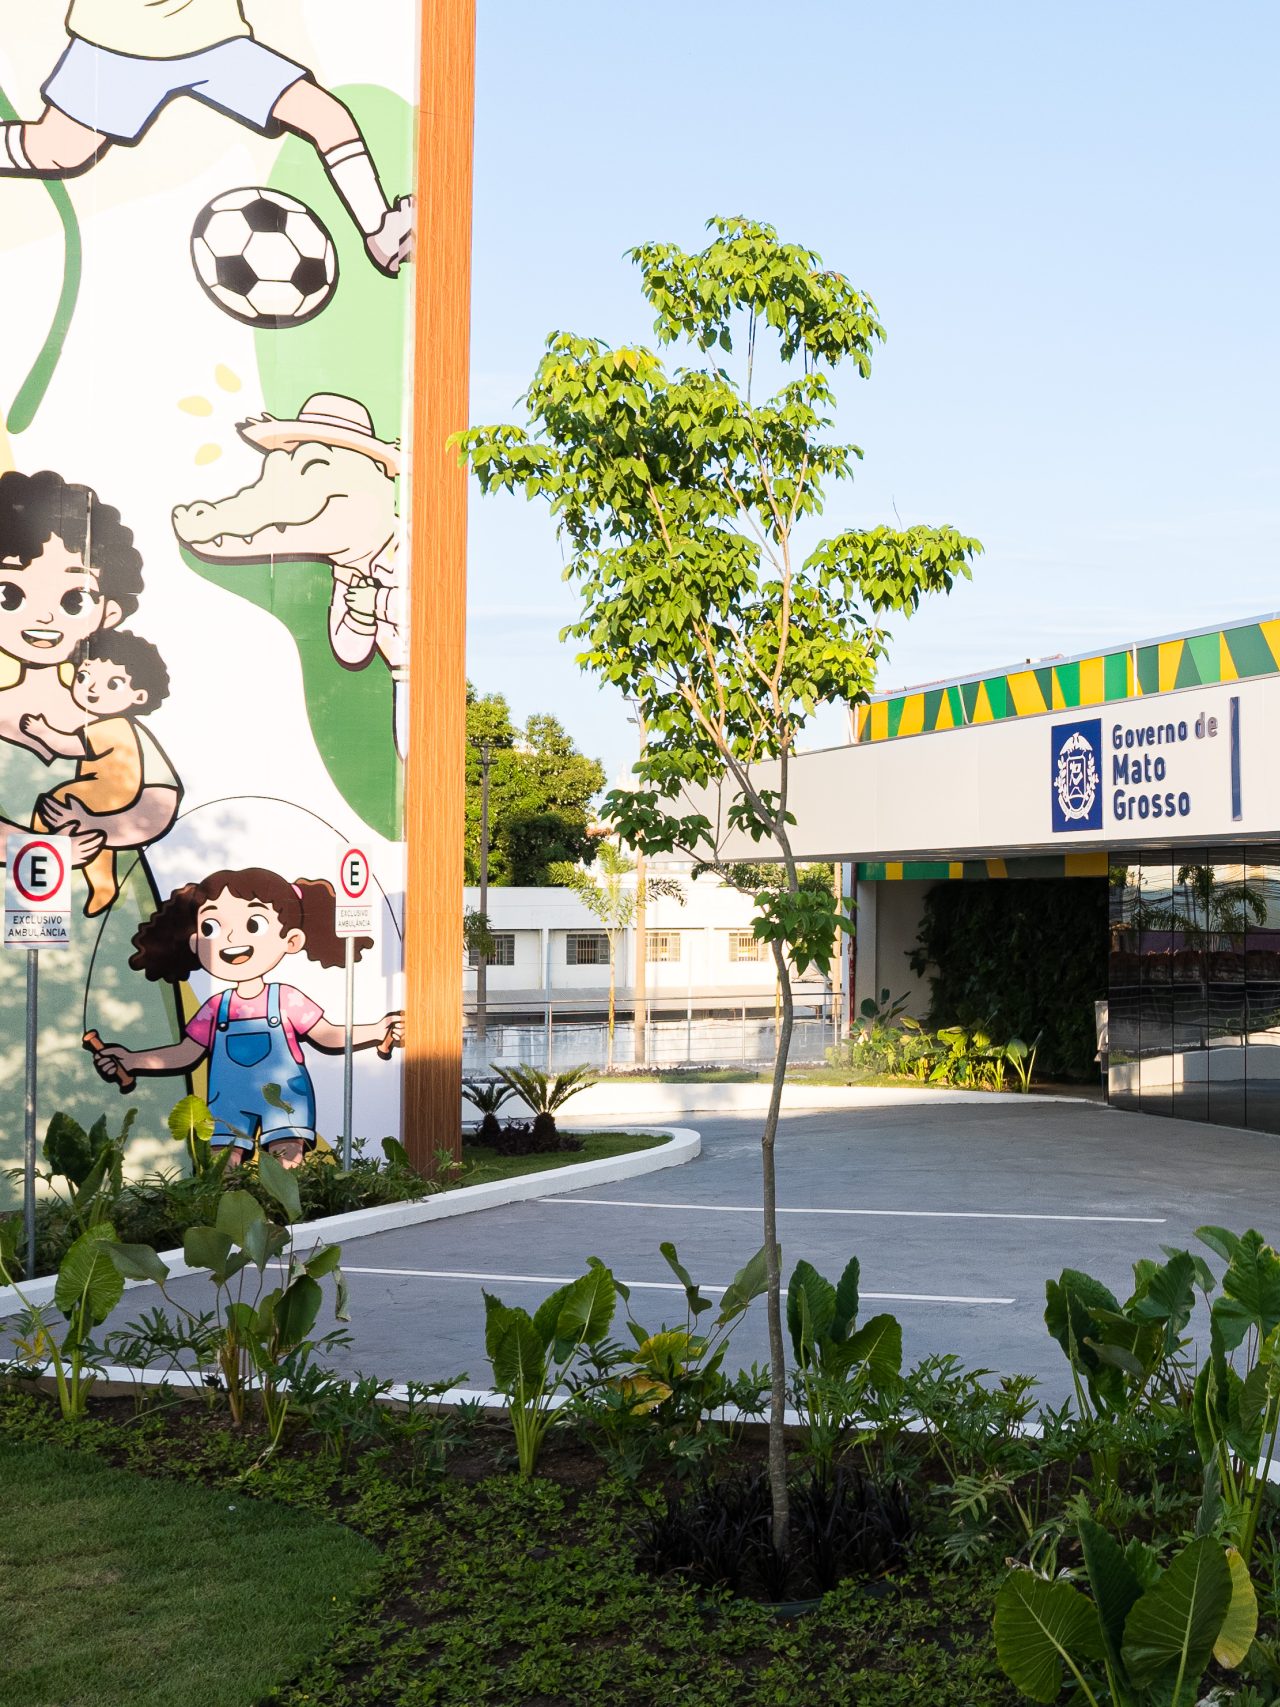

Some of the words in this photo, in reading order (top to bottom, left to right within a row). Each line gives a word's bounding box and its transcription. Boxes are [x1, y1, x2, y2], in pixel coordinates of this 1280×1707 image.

[1112, 721, 1188, 750] Governo
[1195, 711, 1219, 740] de
[1112, 753, 1167, 786] Mato
[1113, 788, 1191, 821] Grosso
[30, 855, 48, 888] E
[350, 861, 360, 886] E
[13, 915, 63, 925] EXCLUSIVO
